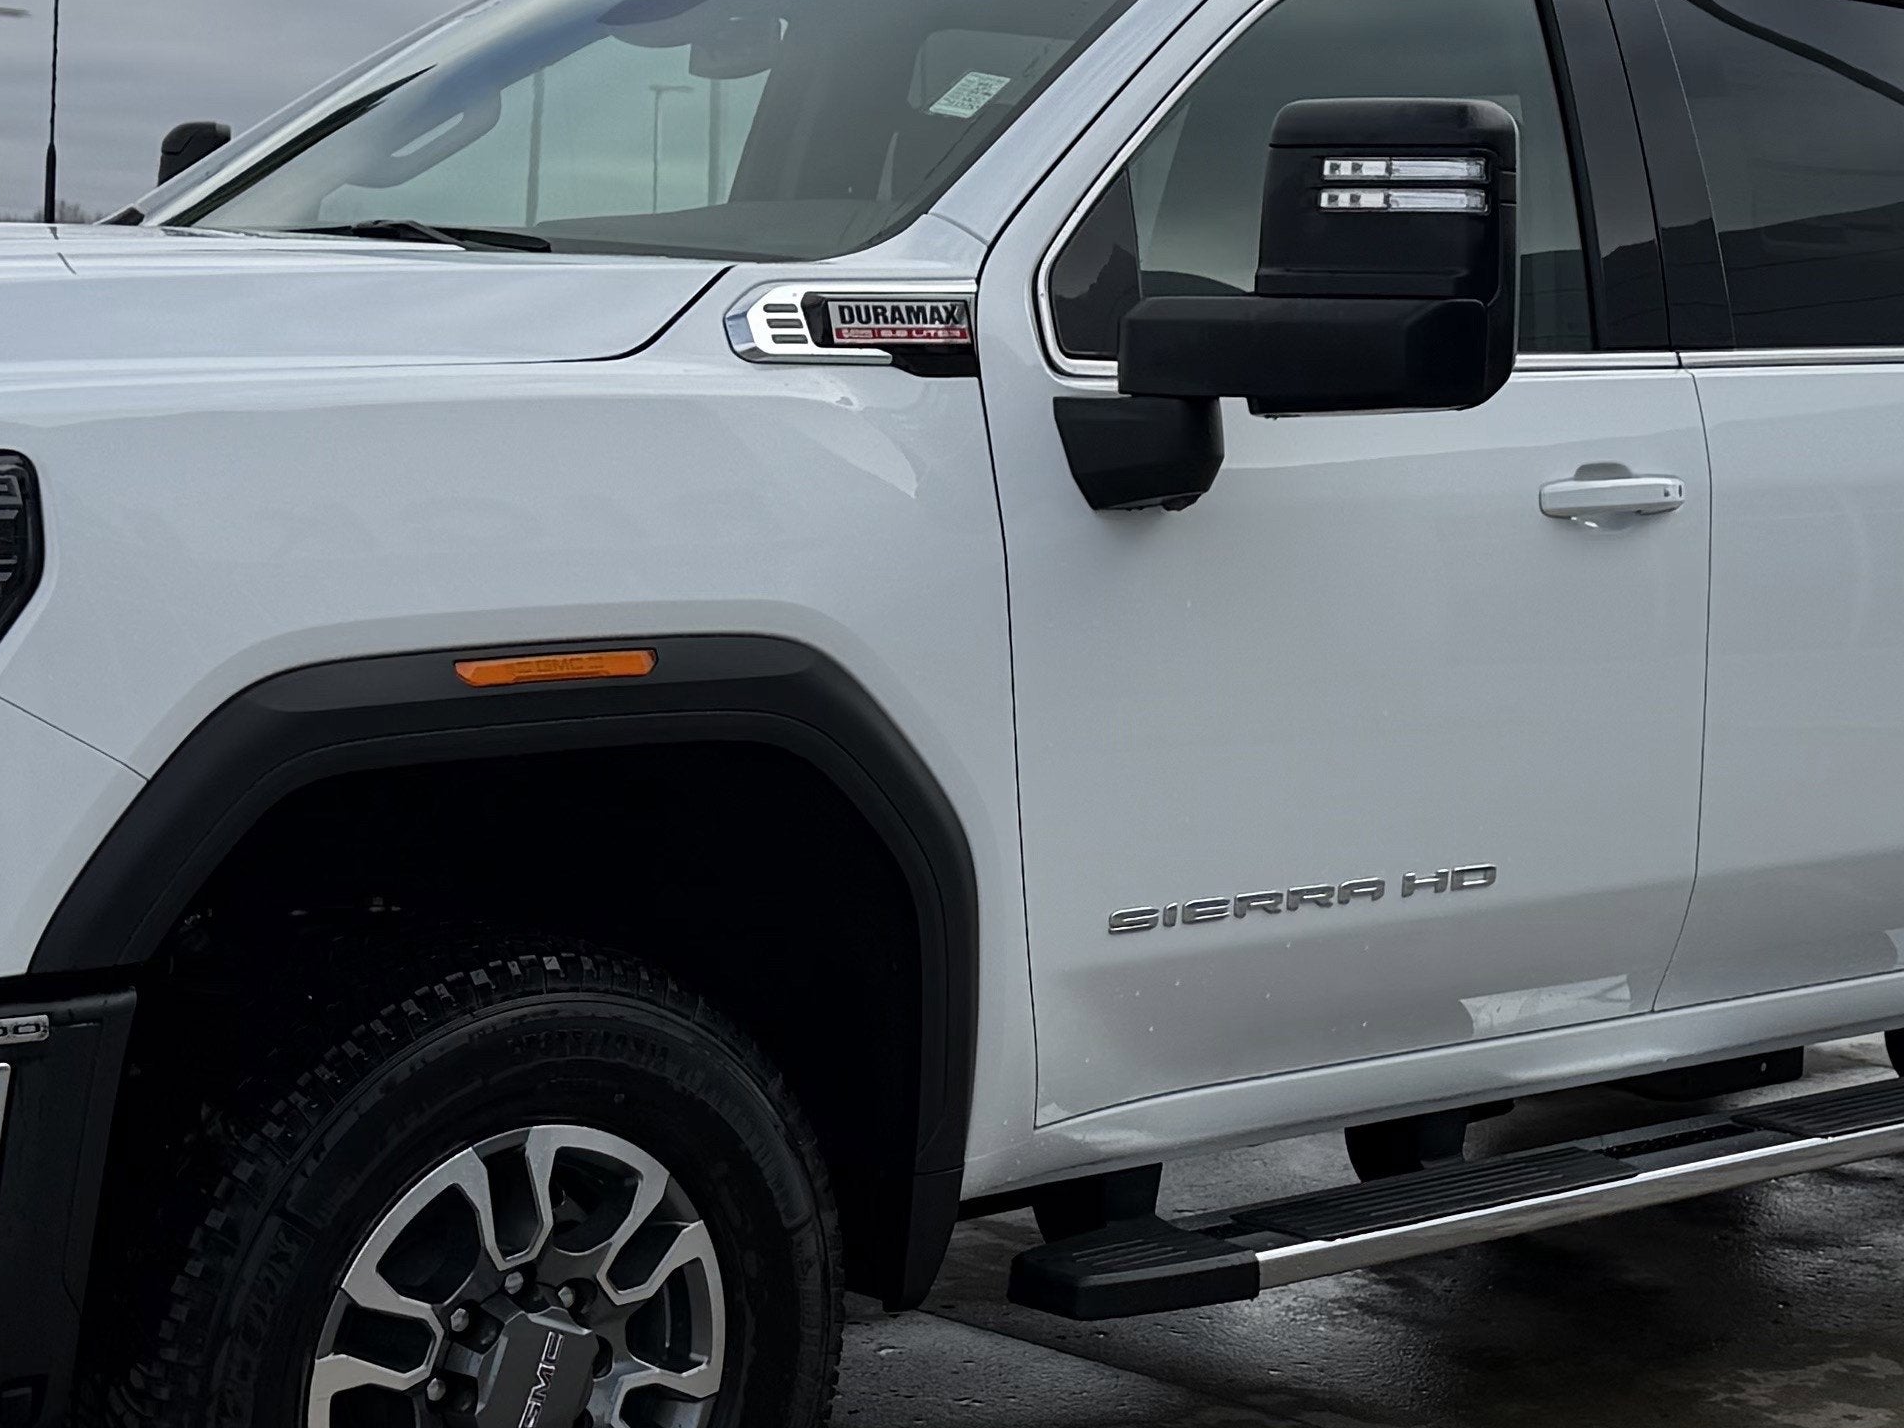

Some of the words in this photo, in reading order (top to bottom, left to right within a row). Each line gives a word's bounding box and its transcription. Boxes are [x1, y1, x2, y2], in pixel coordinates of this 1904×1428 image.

[837, 304, 959, 325] DURAMAX
[1107, 877, 1386, 935] SIERRA
[1400, 863, 1497, 899] HD
